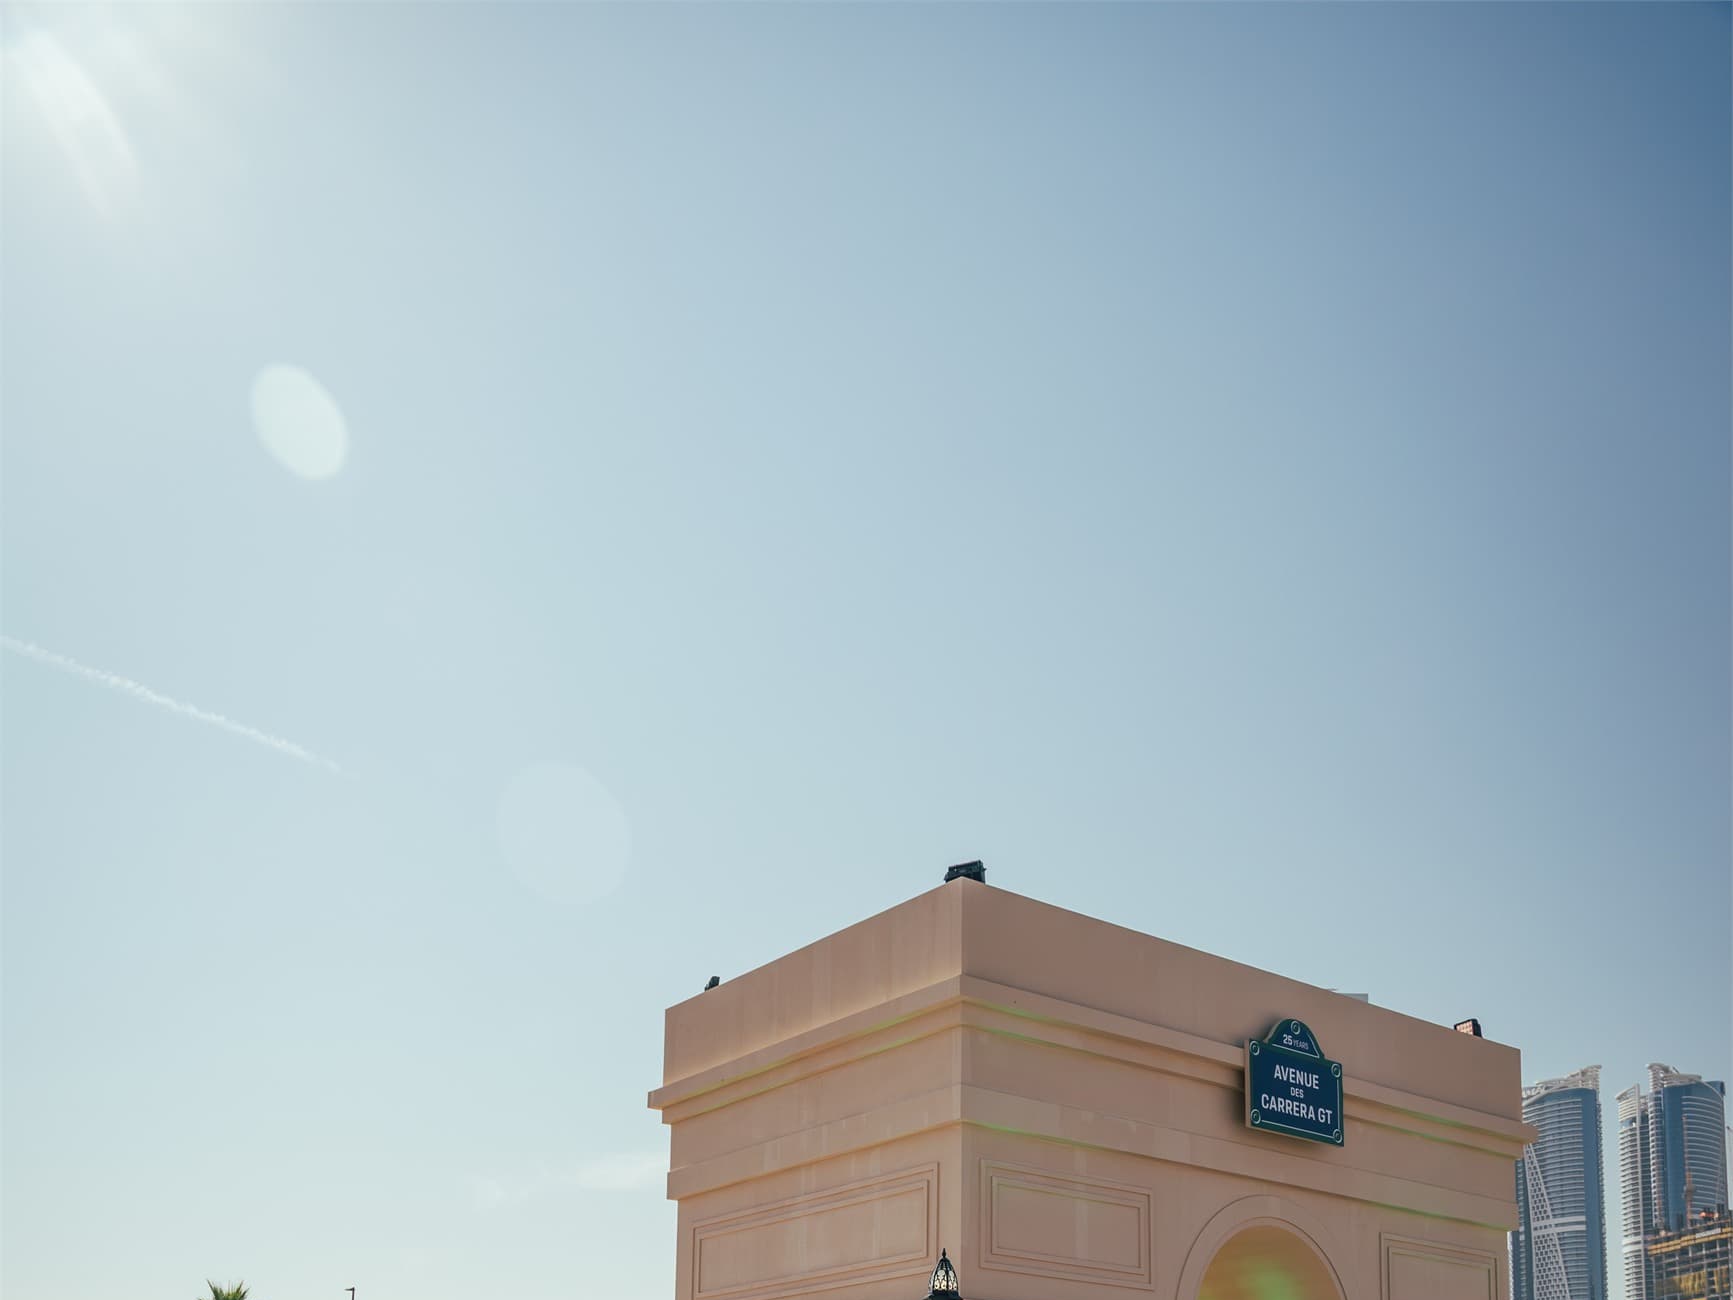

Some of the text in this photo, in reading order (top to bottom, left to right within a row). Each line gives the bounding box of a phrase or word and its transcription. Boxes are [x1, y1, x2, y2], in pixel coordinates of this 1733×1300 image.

[1283, 1034, 1309, 1050] 25 YEARS
[1274, 1064, 1320, 1090] AVENUE
[1290, 1086, 1304, 1098] DES
[1261, 1093, 1333, 1124] CARRERA GT
